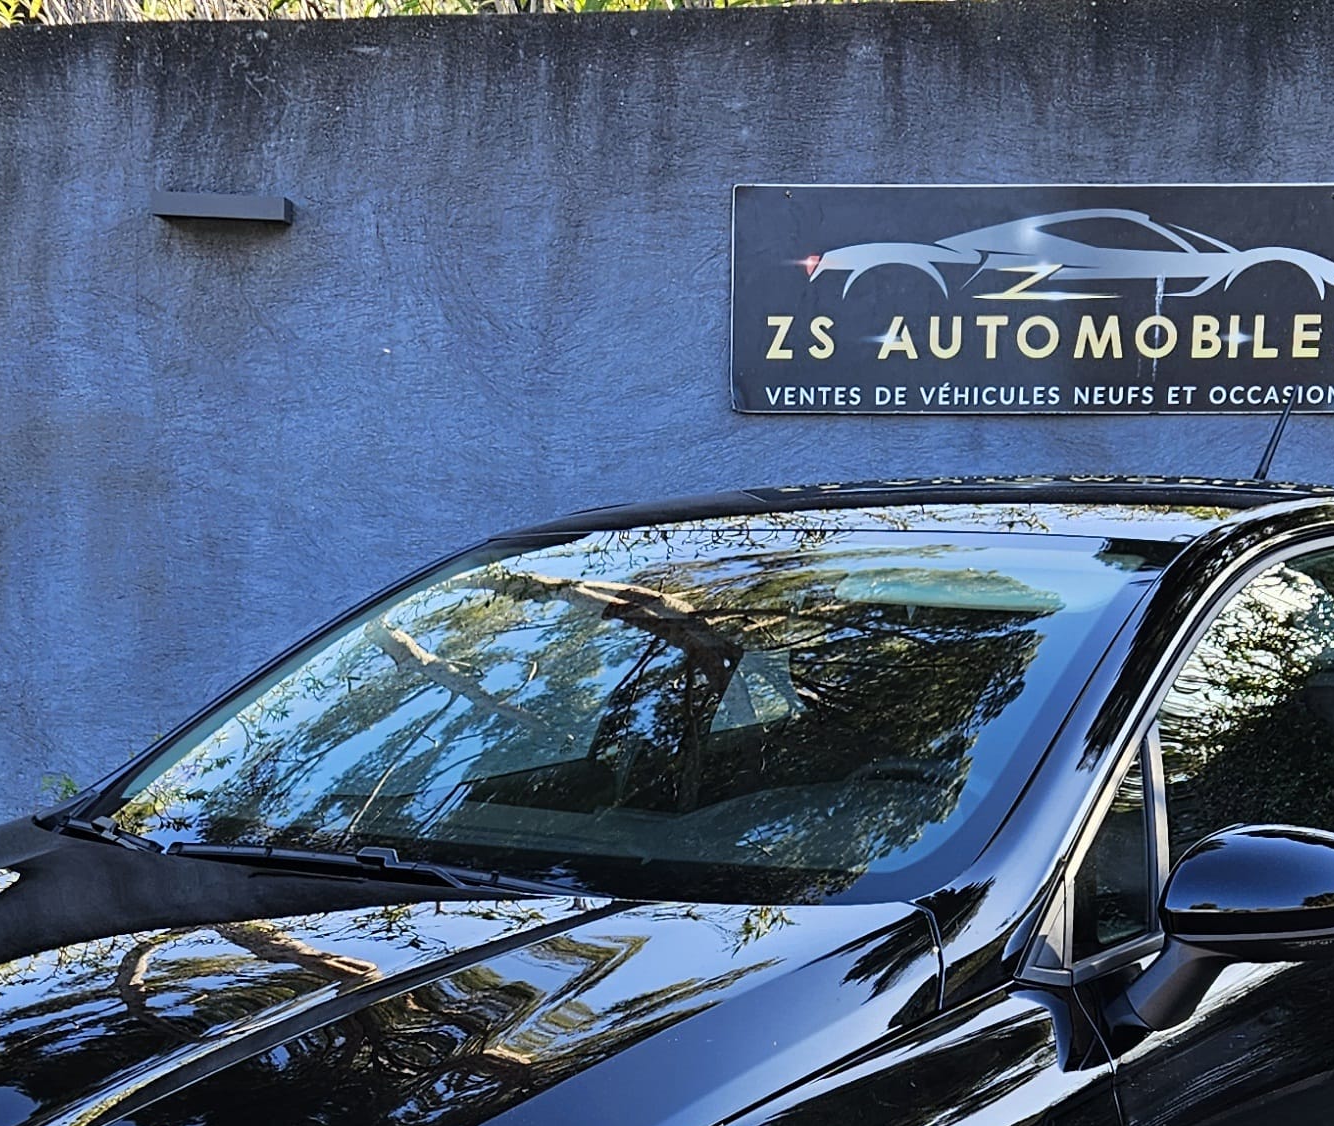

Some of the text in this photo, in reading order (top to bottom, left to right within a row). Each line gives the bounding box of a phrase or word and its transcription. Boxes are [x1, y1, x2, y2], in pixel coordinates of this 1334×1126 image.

[765, 315, 836, 360] ZS
[765, 386, 862, 405] VENTES
[875, 386, 907, 405] DE
[919, 382, 1060, 405] VÉHICULES
[1074, 386, 1154, 405] NEUFS
[1167, 386, 1197, 404] ET
